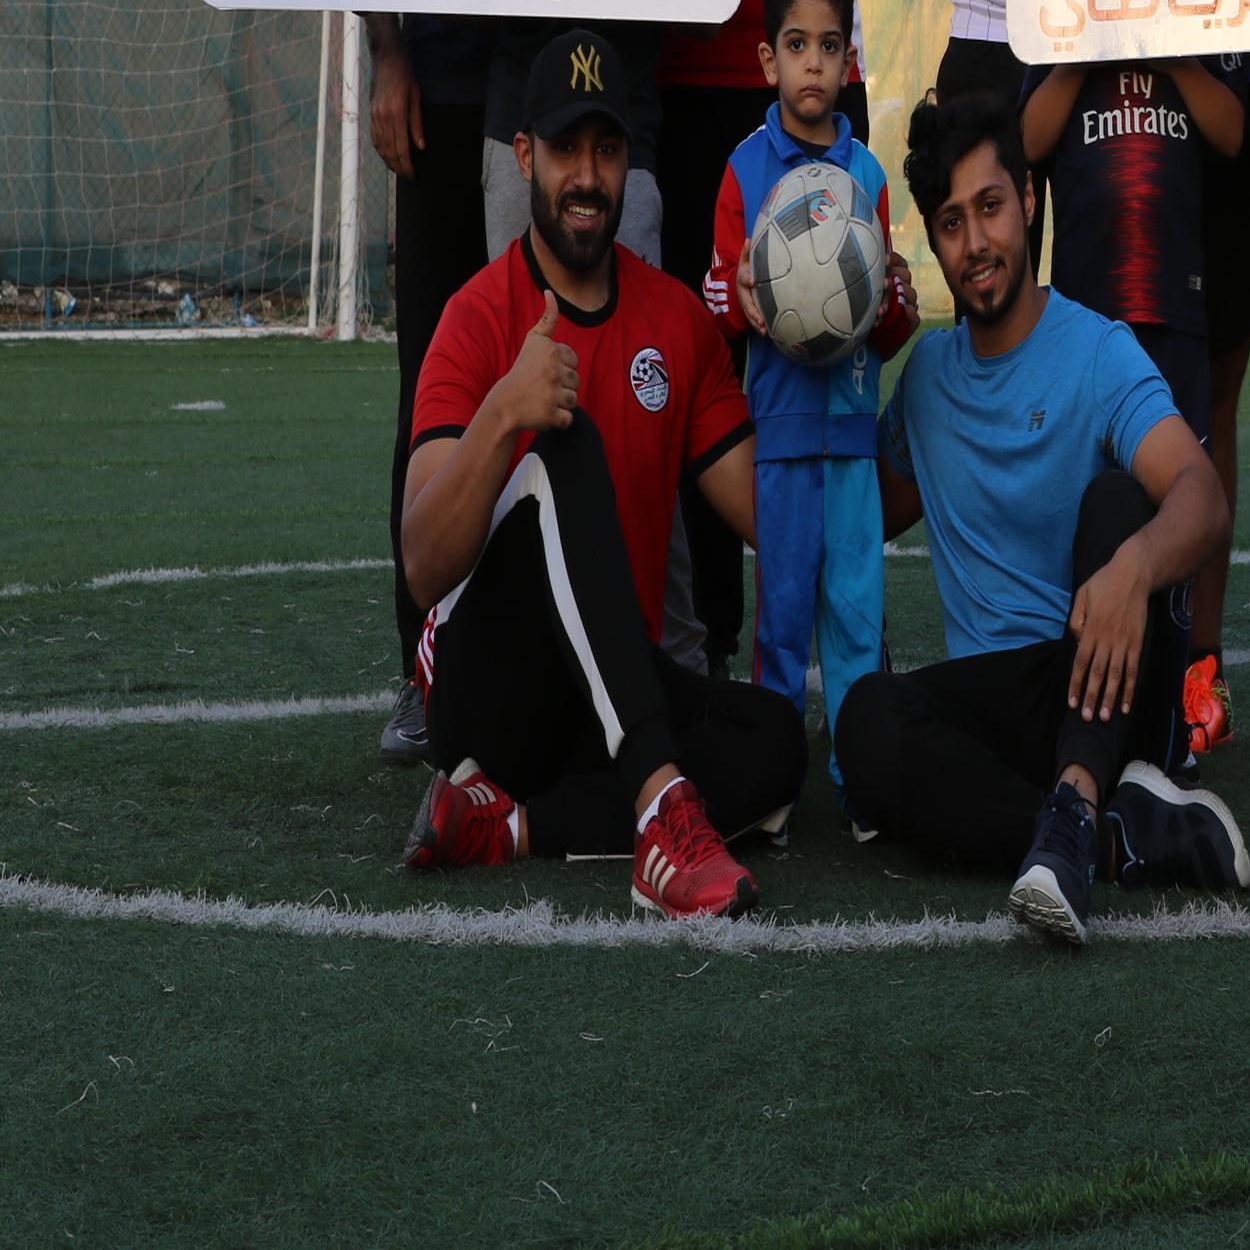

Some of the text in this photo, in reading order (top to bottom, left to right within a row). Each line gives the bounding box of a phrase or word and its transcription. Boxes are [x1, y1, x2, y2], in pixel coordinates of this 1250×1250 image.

[570, 43, 604, 92] NY
[1119, 71, 1153, 99] Fly
[1082, 100, 1188, 145] Emirates
